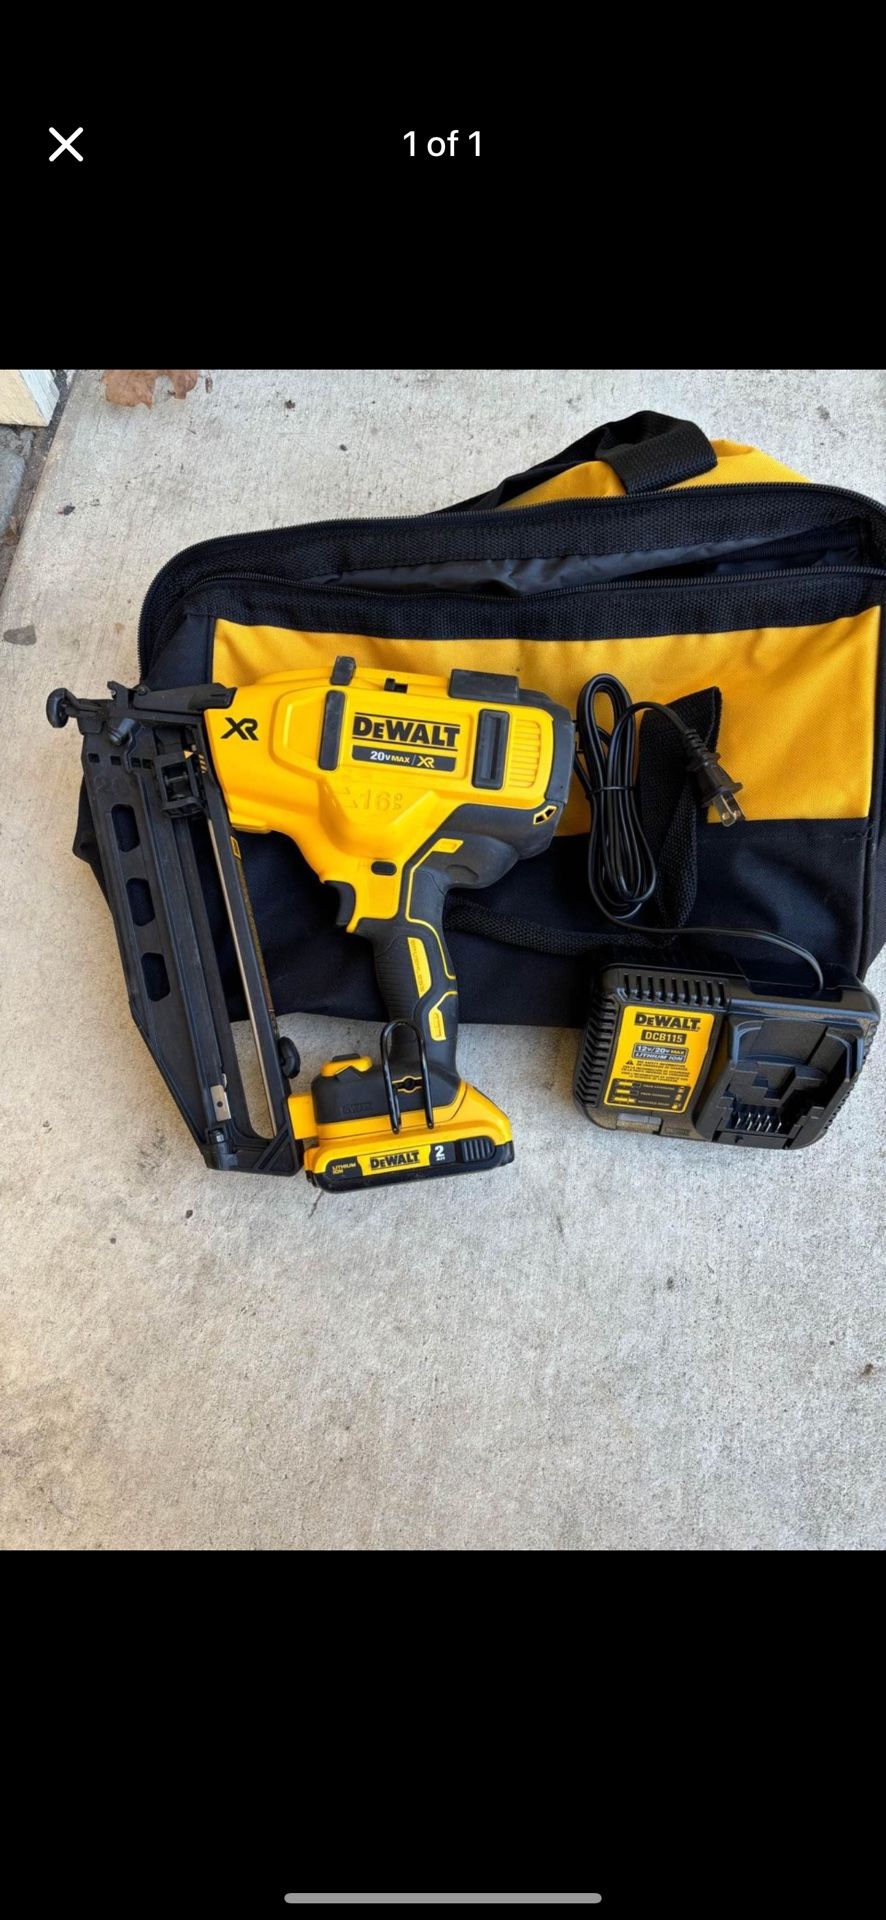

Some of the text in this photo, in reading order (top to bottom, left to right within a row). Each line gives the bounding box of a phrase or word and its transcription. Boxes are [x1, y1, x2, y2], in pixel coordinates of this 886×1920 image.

[220, 717, 259, 741] XR
[352, 714, 461, 748] DEWALT
[391, 755, 410, 764] MAX
[416, 756, 435, 769] XR
[634, 1014, 700, 1030] DEWALT
[645, 1031, 683, 1043] DCB115
[434, 1145, 445, 1158] 2
[332, 1162, 357, 1171] LITHIUM
[370, 1151, 420, 1170] DEWALT
